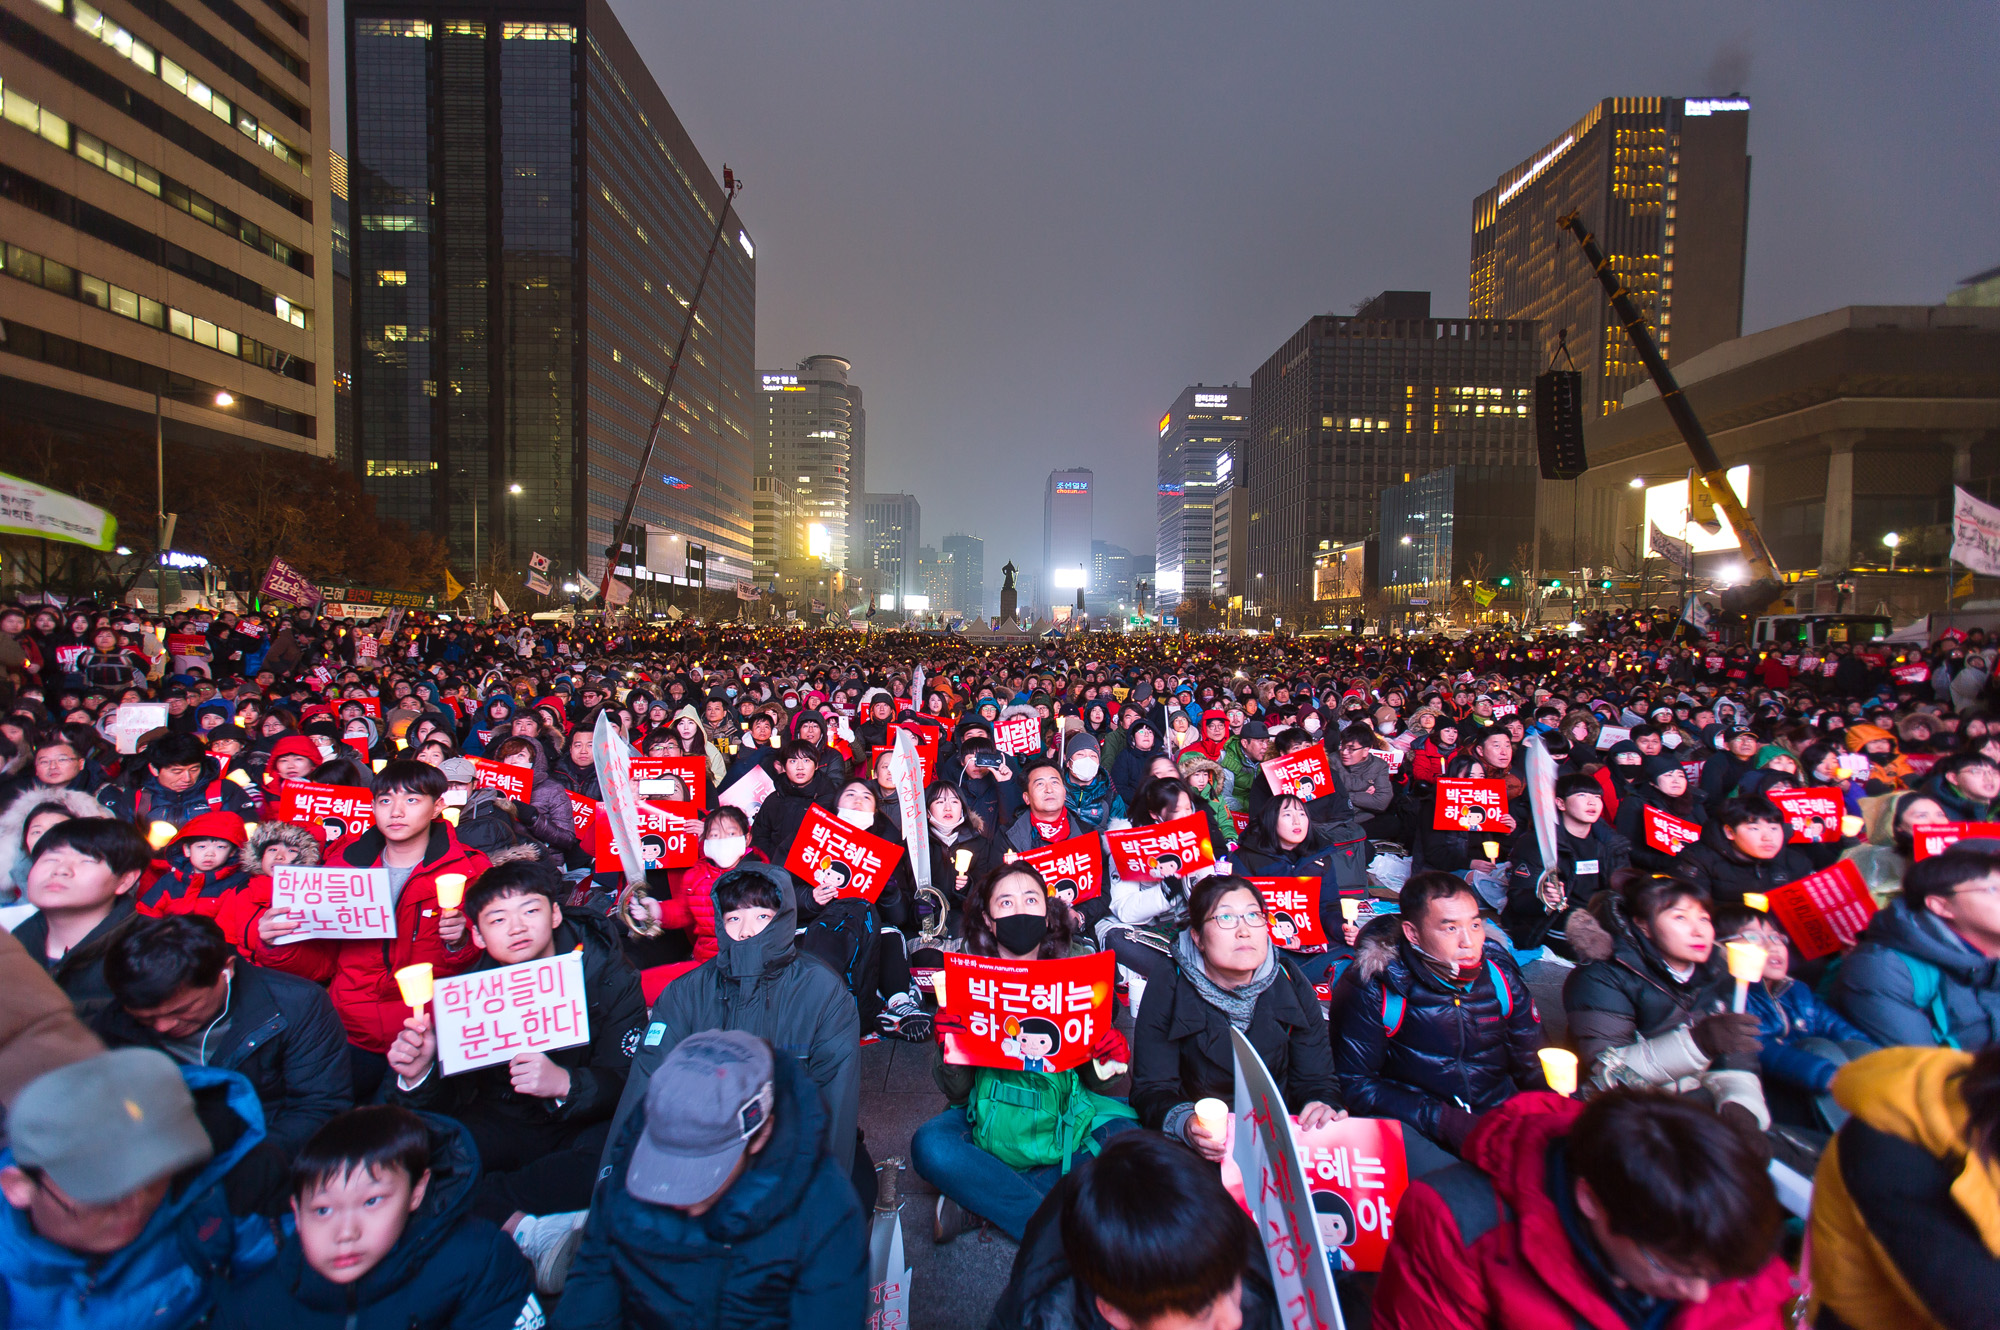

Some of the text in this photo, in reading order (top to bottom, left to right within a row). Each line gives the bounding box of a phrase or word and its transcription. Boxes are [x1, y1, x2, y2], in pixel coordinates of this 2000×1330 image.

[1056, 481, 1089, 490] 조선일보
[994, 718, 1041, 744] 내려와
[1274, 757, 1322, 781] 박근혜는
[294, 793, 374, 818] 박근혜는
[1446, 788, 1501, 806] 박근혜는
[1782, 798, 1837, 815] 박근혜는
[811, 823, 882, 874] 박근혜는
[1121, 830, 1198, 857] 박근혜는
[278, 869, 375, 905] 학생들이
[285, 905, 390, 936] 분노한다
[950, 957, 1029, 974] 나눔문화 www.nanum.com
[441, 961, 566, 1019] 학생들이
[968, 977, 1095, 1015] 박근혜는
[459, 999, 583, 1061] 분노한다
